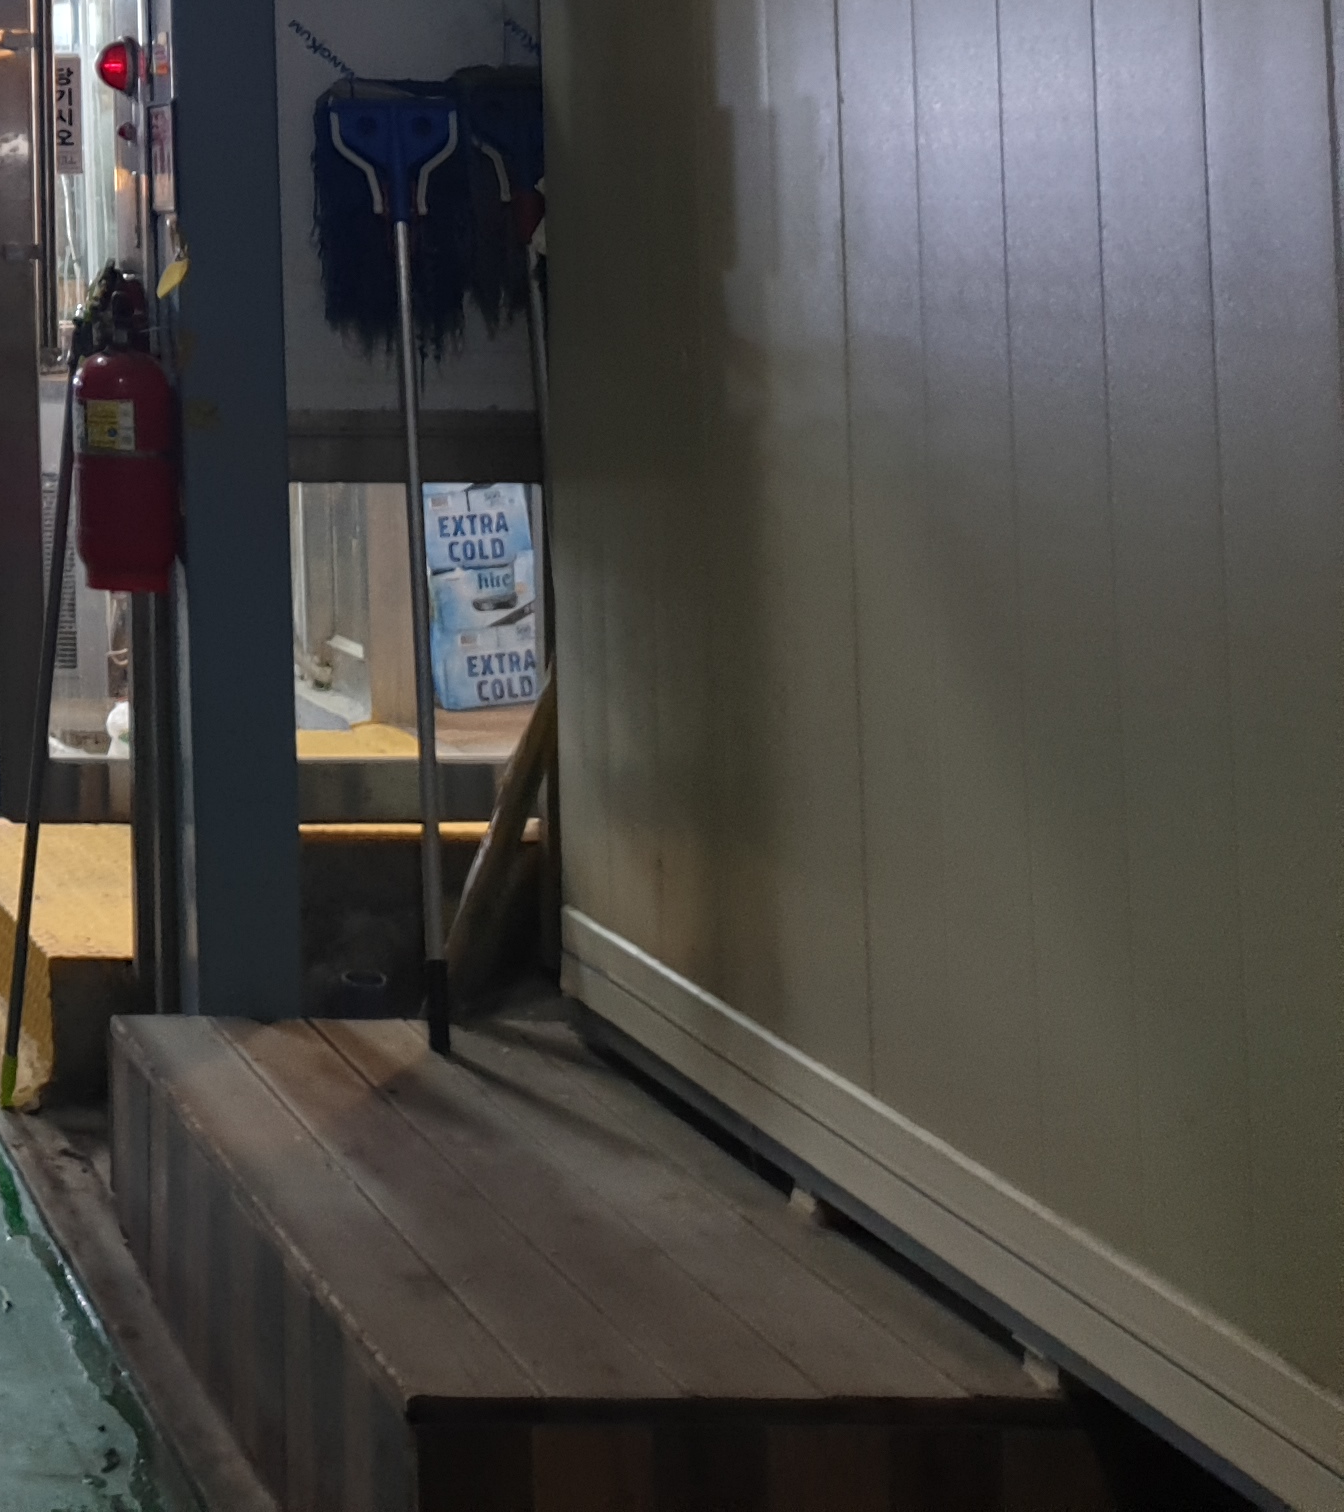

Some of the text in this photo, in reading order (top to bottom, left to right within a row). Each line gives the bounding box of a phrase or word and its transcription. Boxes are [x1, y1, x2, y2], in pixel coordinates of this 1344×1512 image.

[56, 67, 75, 147] 당기시오
[438, 511, 509, 539] EXTRA
[448, 538, 506, 564] COLD
[466, 648, 536, 678] EXTRA
[476, 675, 534, 703] COLD
